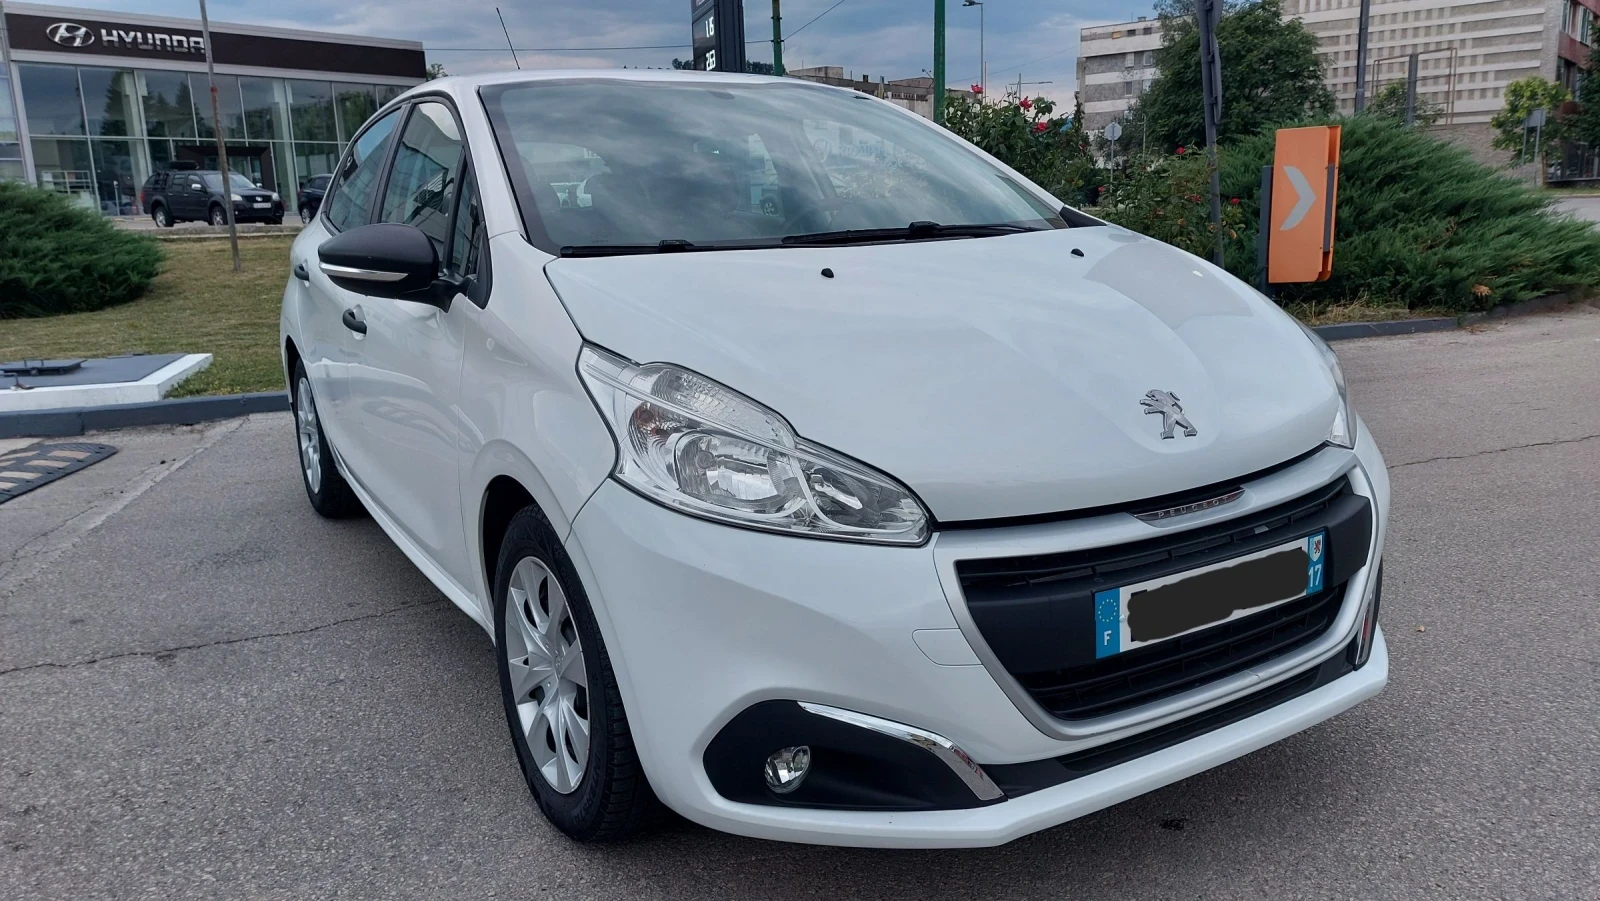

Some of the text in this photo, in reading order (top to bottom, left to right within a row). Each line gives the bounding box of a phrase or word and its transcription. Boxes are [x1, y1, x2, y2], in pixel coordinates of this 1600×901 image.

[100, 28, 206, 54] HYUNDA
[1157, 495, 1229, 519] PEUGEOT
[1307, 564, 1322, 588] 17
[1103, 630, 1112, 646] F
